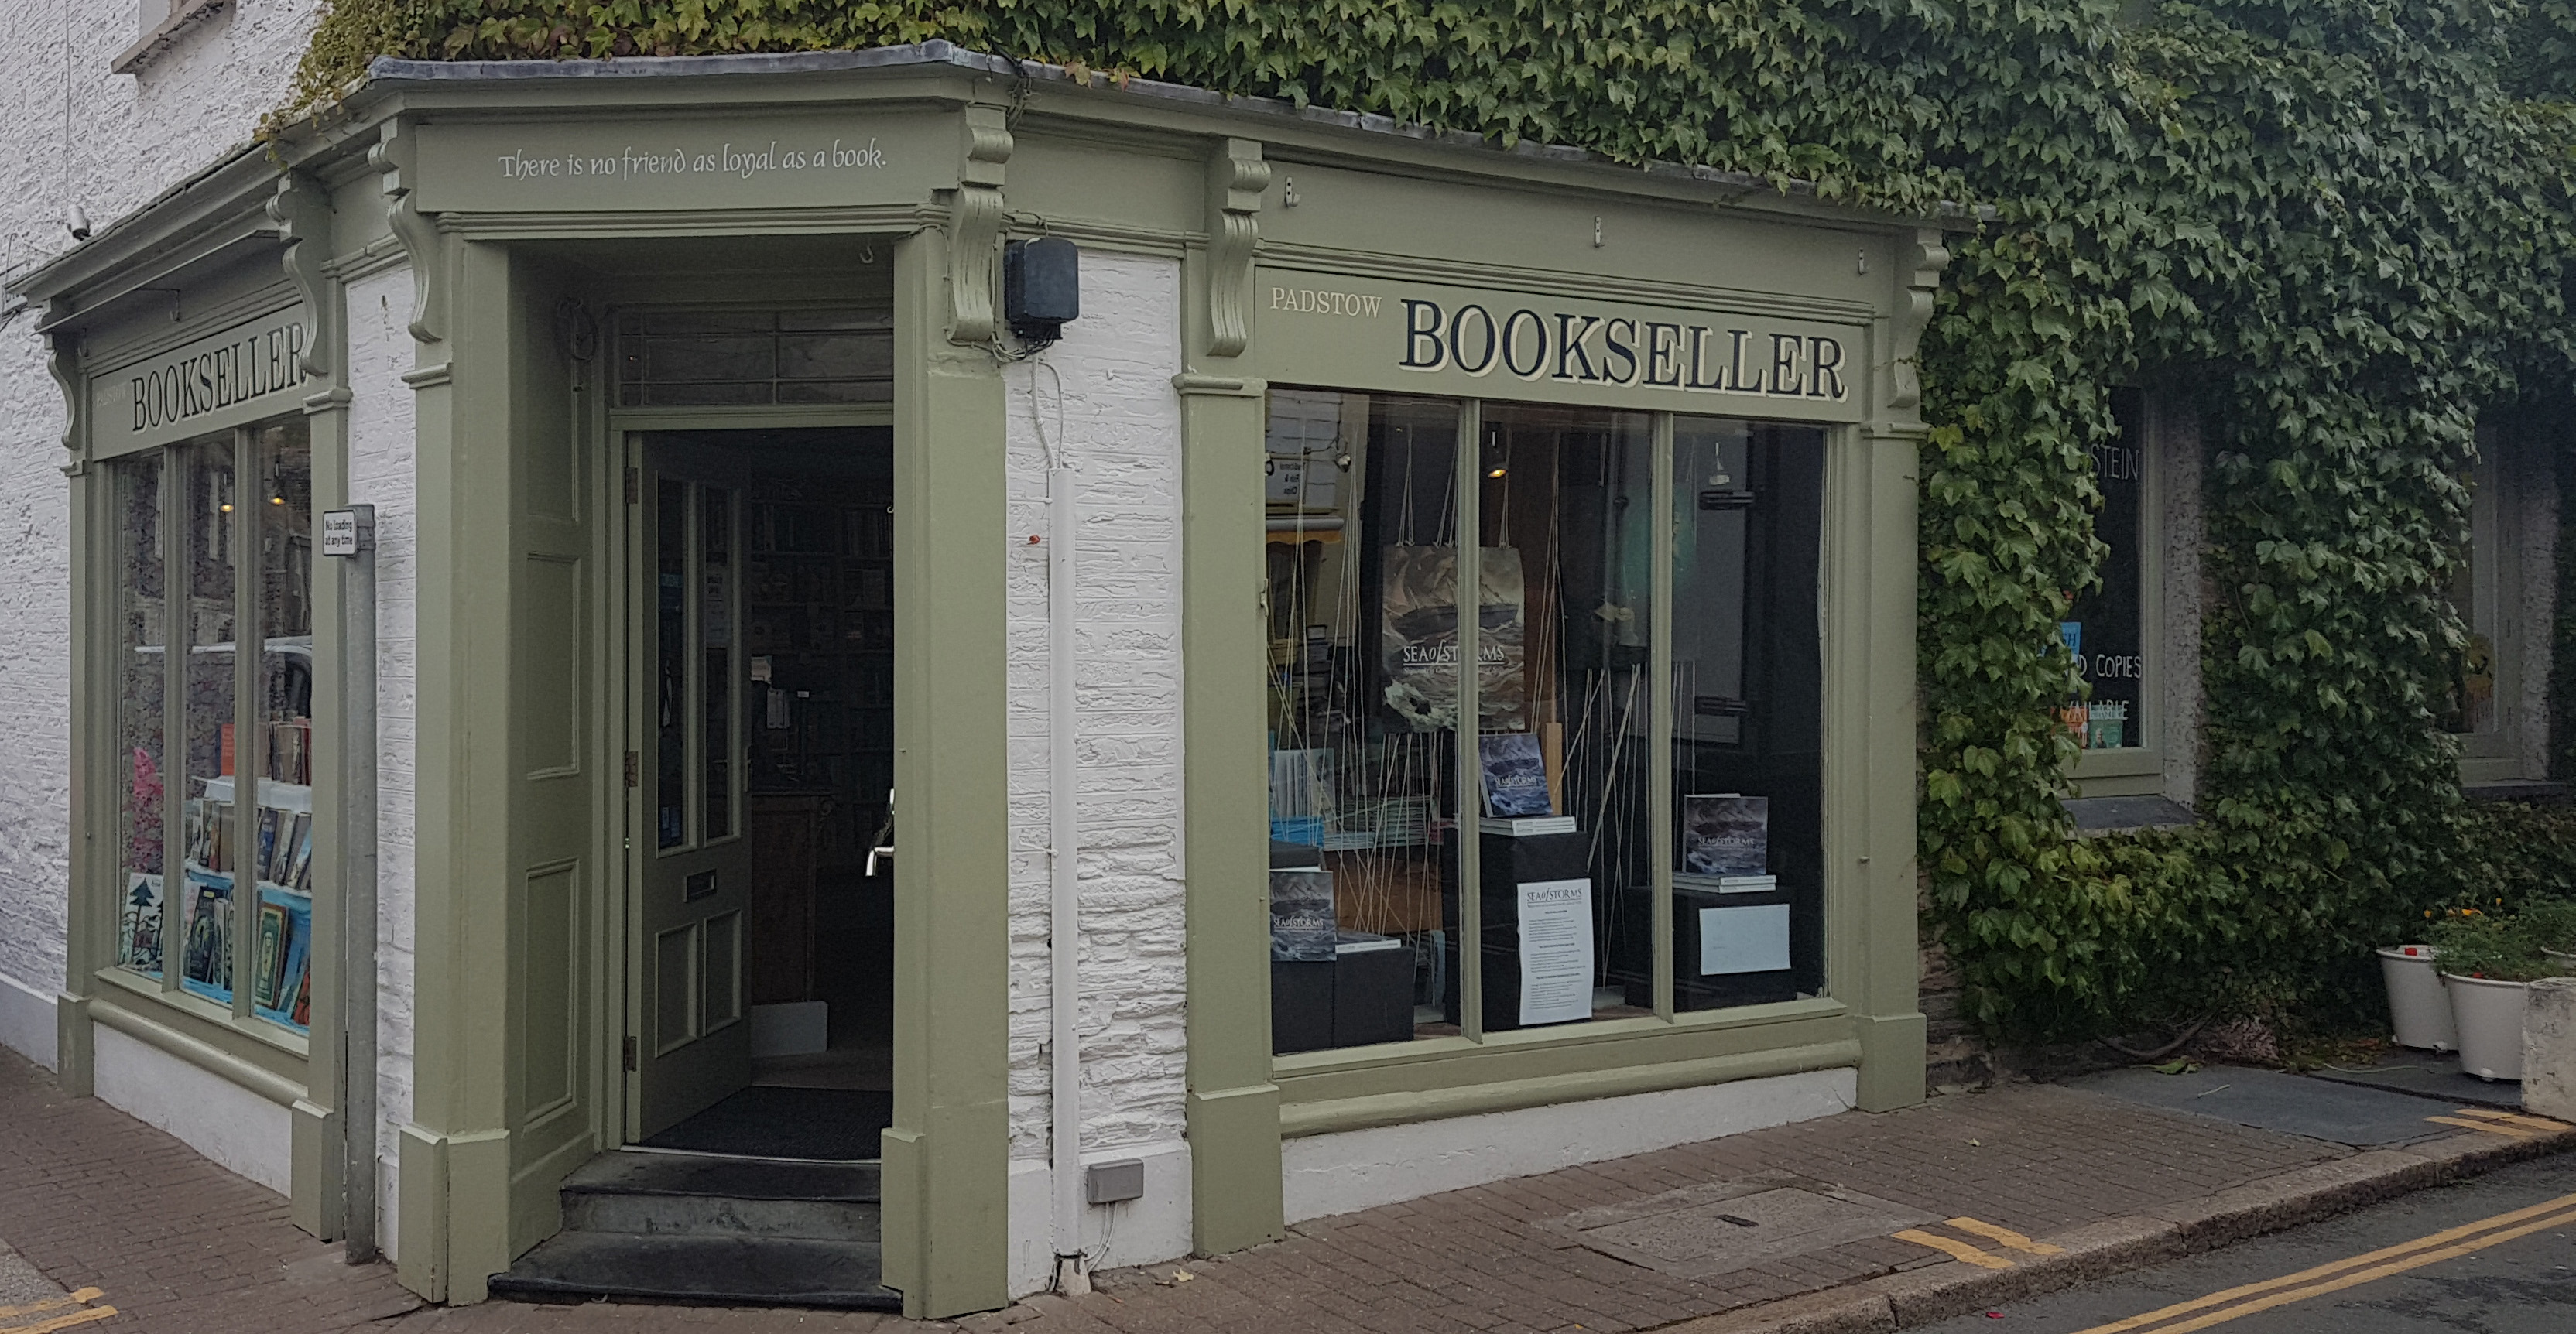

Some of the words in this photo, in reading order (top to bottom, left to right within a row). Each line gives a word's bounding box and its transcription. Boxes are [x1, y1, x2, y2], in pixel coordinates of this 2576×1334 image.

[498, 149, 560, 181] There
[567, 154, 583, 176] is
[590, 157, 616, 176] no
[622, 145, 687, 181] friend
[693, 153, 716, 172] as
[723, 141, 778, 180] loyal
[783, 150, 807, 169] as
[813, 150, 827, 168] a
[831, 137, 887, 169] book.
[1269, 286, 1382, 319] PADSTOW
[1399, 298, 1849, 403] BOOKSELLER
[131, 322, 310, 435] BOOKSELLER
[324, 535, 331, 546] at
[331, 537, 341, 548] any
[341, 535, 353, 545] time
[325, 520, 332, 531] No
[333, 519, 352, 532] loading
[2095, 654, 2143, 679] COPIES
